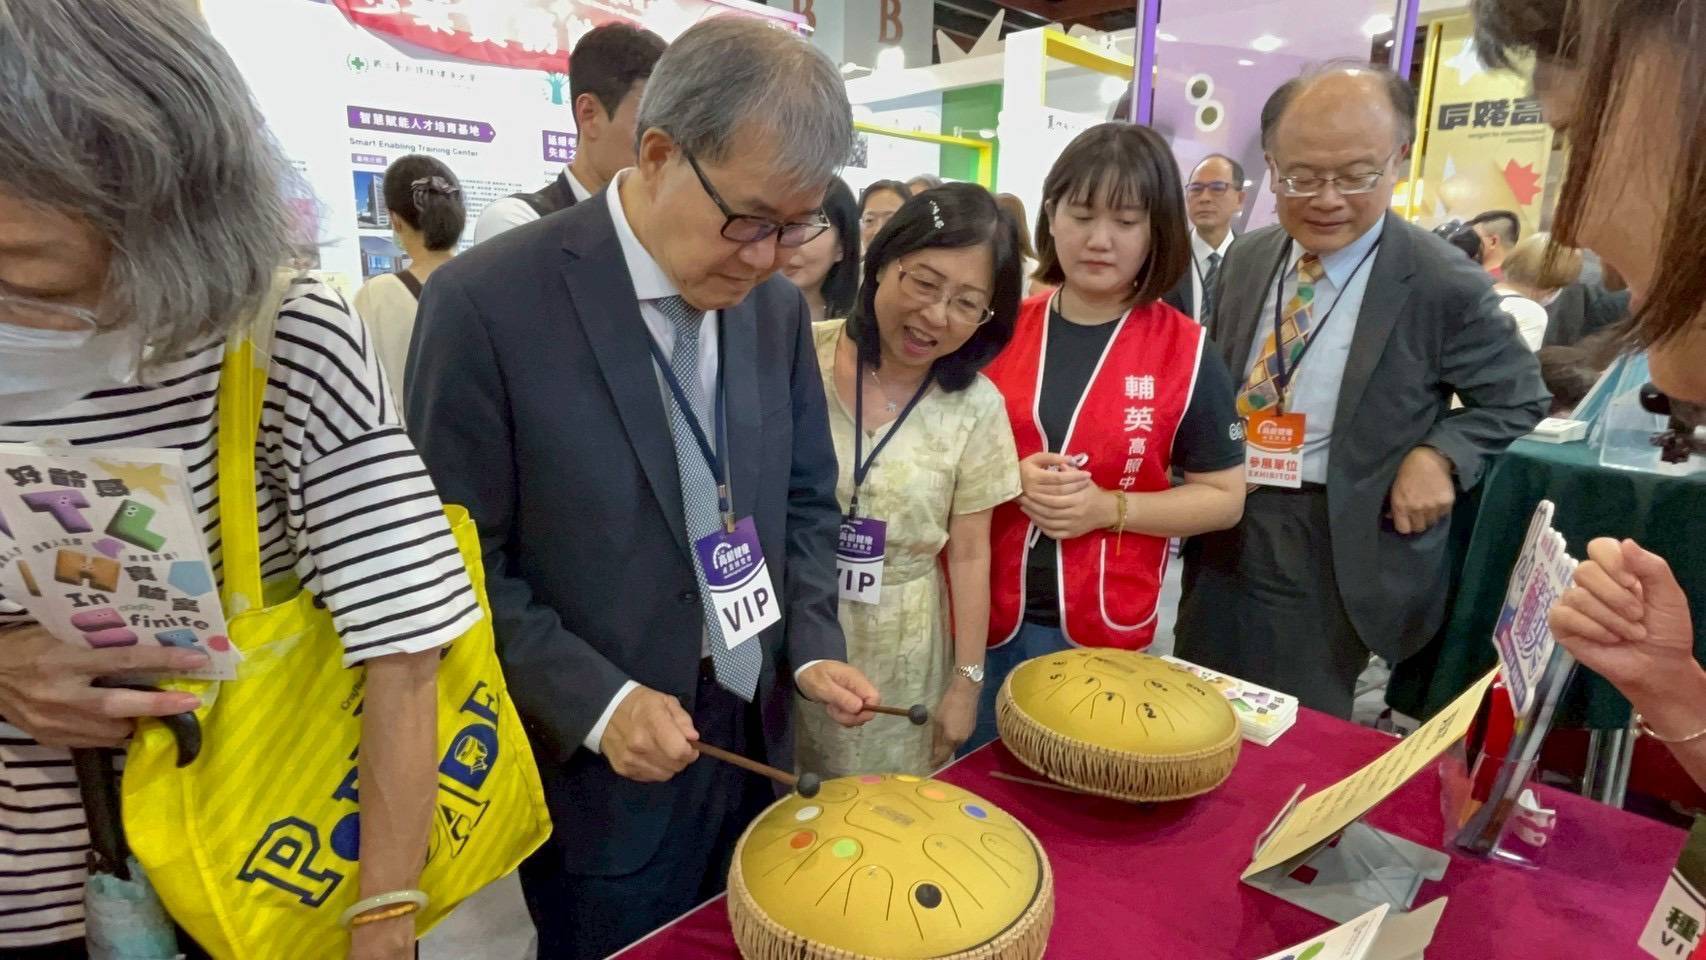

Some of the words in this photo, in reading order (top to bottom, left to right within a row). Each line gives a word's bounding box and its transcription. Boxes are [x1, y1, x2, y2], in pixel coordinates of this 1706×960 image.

[359, 111, 480, 137] 智慧賦能人才培育基地
[350, 137, 376, 147] Smart
[379, 141, 416, 152] Enabling
[418, 144, 450, 155] Training
[452, 148, 478, 156] Center
[1249, 456, 1298, 472] 參展單位
[1248, 469, 1297, 481] EXHIBITOR
[722, 587, 770, 633] VIP
